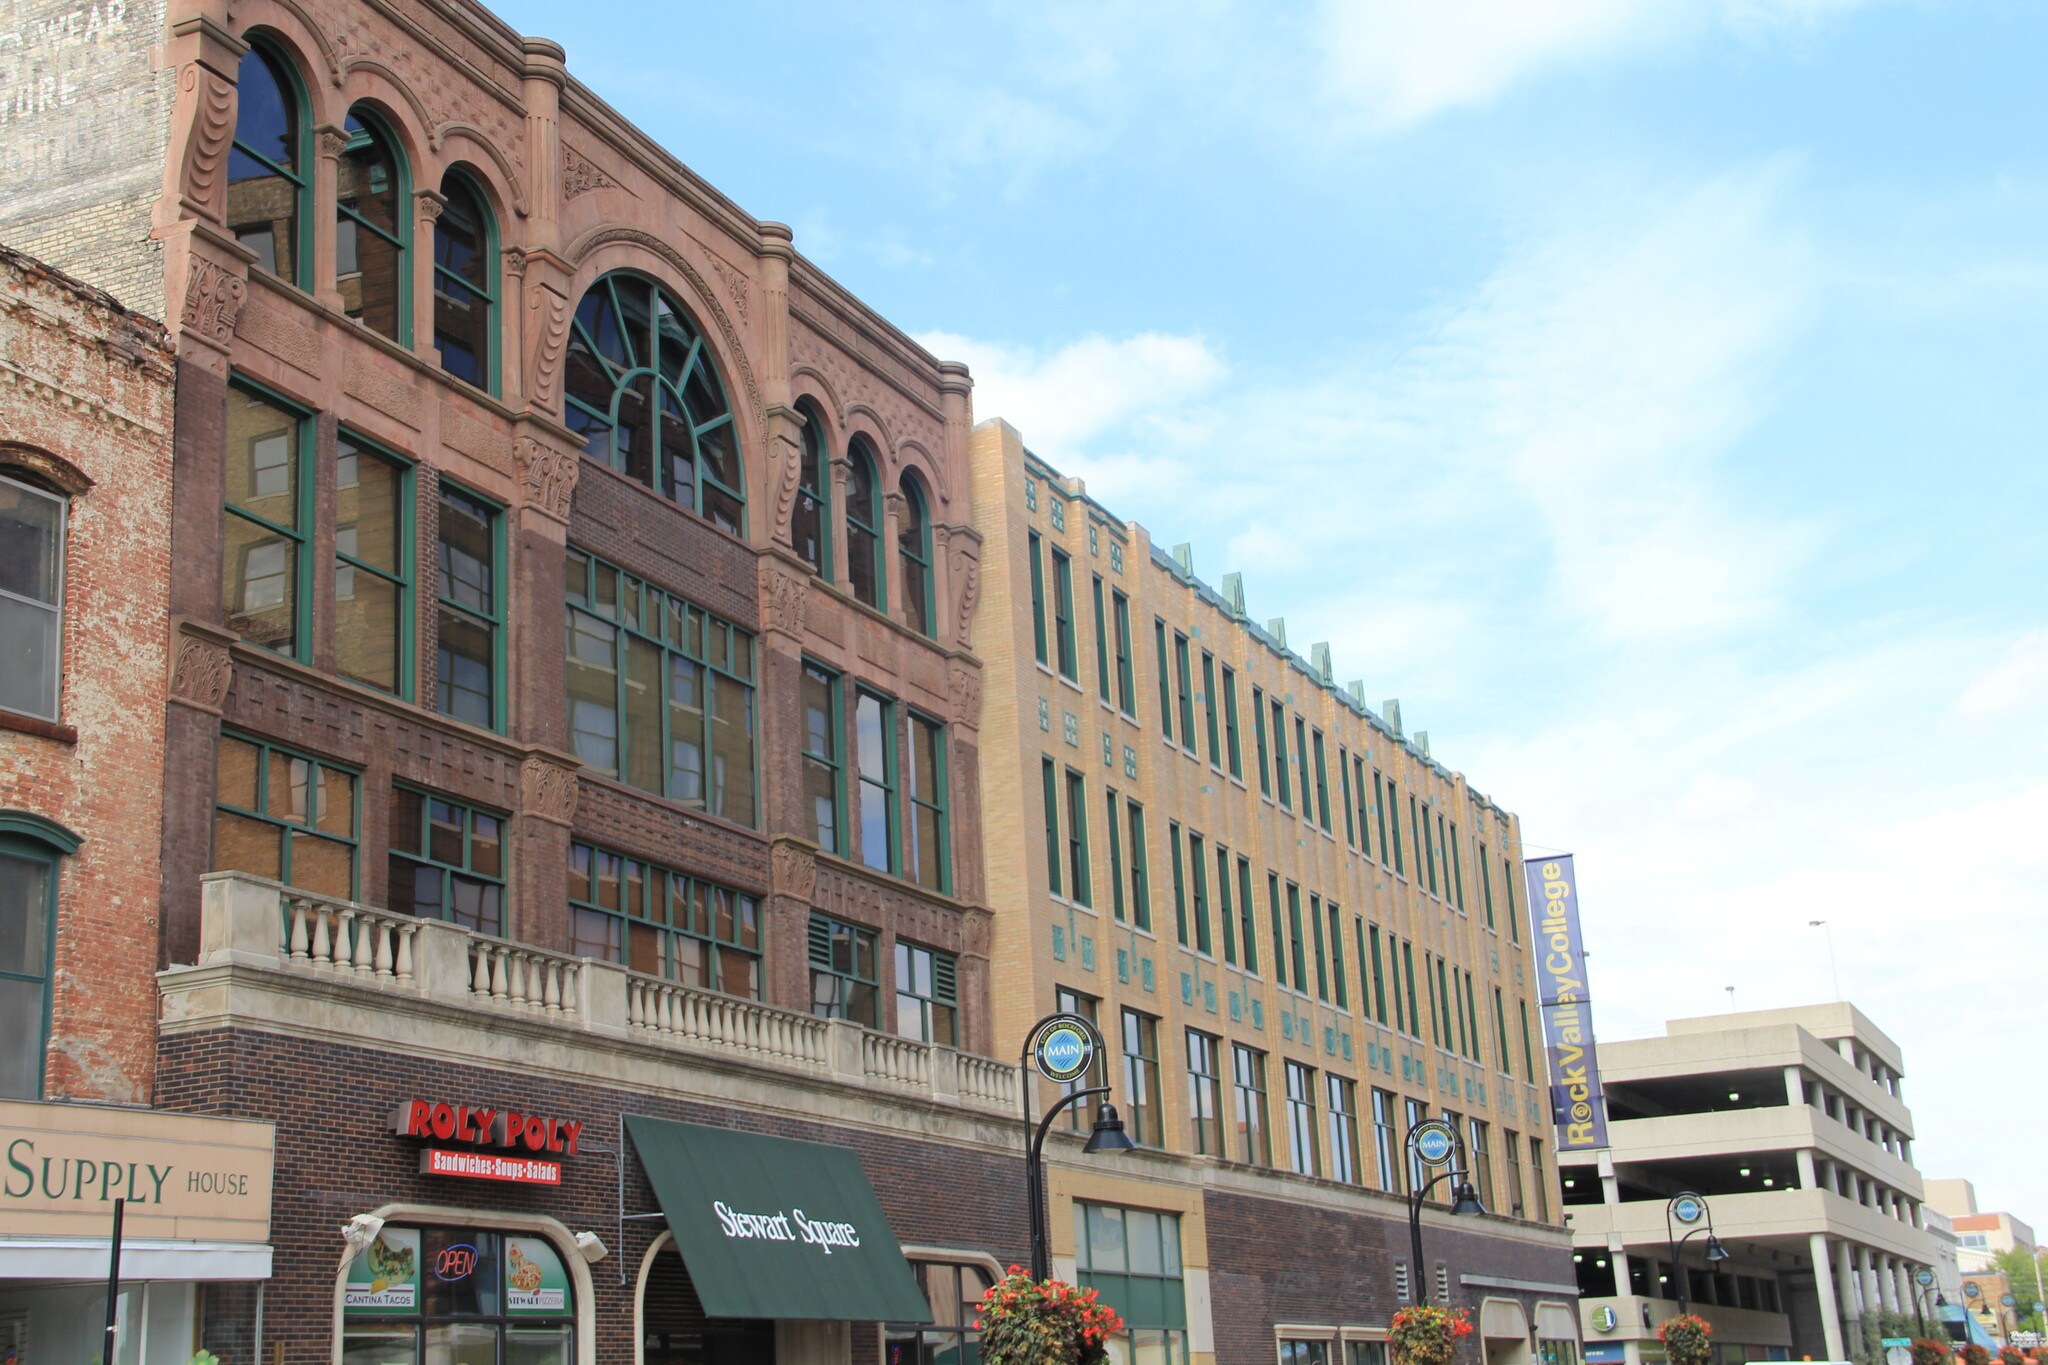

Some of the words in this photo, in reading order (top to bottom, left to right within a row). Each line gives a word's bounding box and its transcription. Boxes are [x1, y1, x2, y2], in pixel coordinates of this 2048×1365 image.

[1541, 861, 1572, 975] College
[1040, 1030, 1050, 1044] CITY
[1058, 1023, 1087, 1040] ROCKFORD
[1552, 975, 1585, 1067] Valley
[1048, 1044, 1079, 1056] MAIN
[1050, 1068, 1080, 1079] WELCOME
[1561, 1065, 1594, 1145] Rock
[407, 1099, 497, 1145] ROLY
[505, 1111, 584, 1155] POLY
[1422, 1140, 1446, 1149] MAIN
[4, 1138, 175, 1204] SUPPLY
[187, 1170, 248, 1195] HOUSE
[433, 1151, 492, 1175] Sandwiches
[494, 1158, 523, 1180] Soups
[526, 1162, 557, 1181] Salads
[713, 1200, 796, 1241] Stewart
[792, 1208, 860, 1254] Square
[436, 1250, 476, 1275] OPEN
[345, 1293, 382, 1304] CANTINA
[384, 1294, 411, 1304] TACOS
